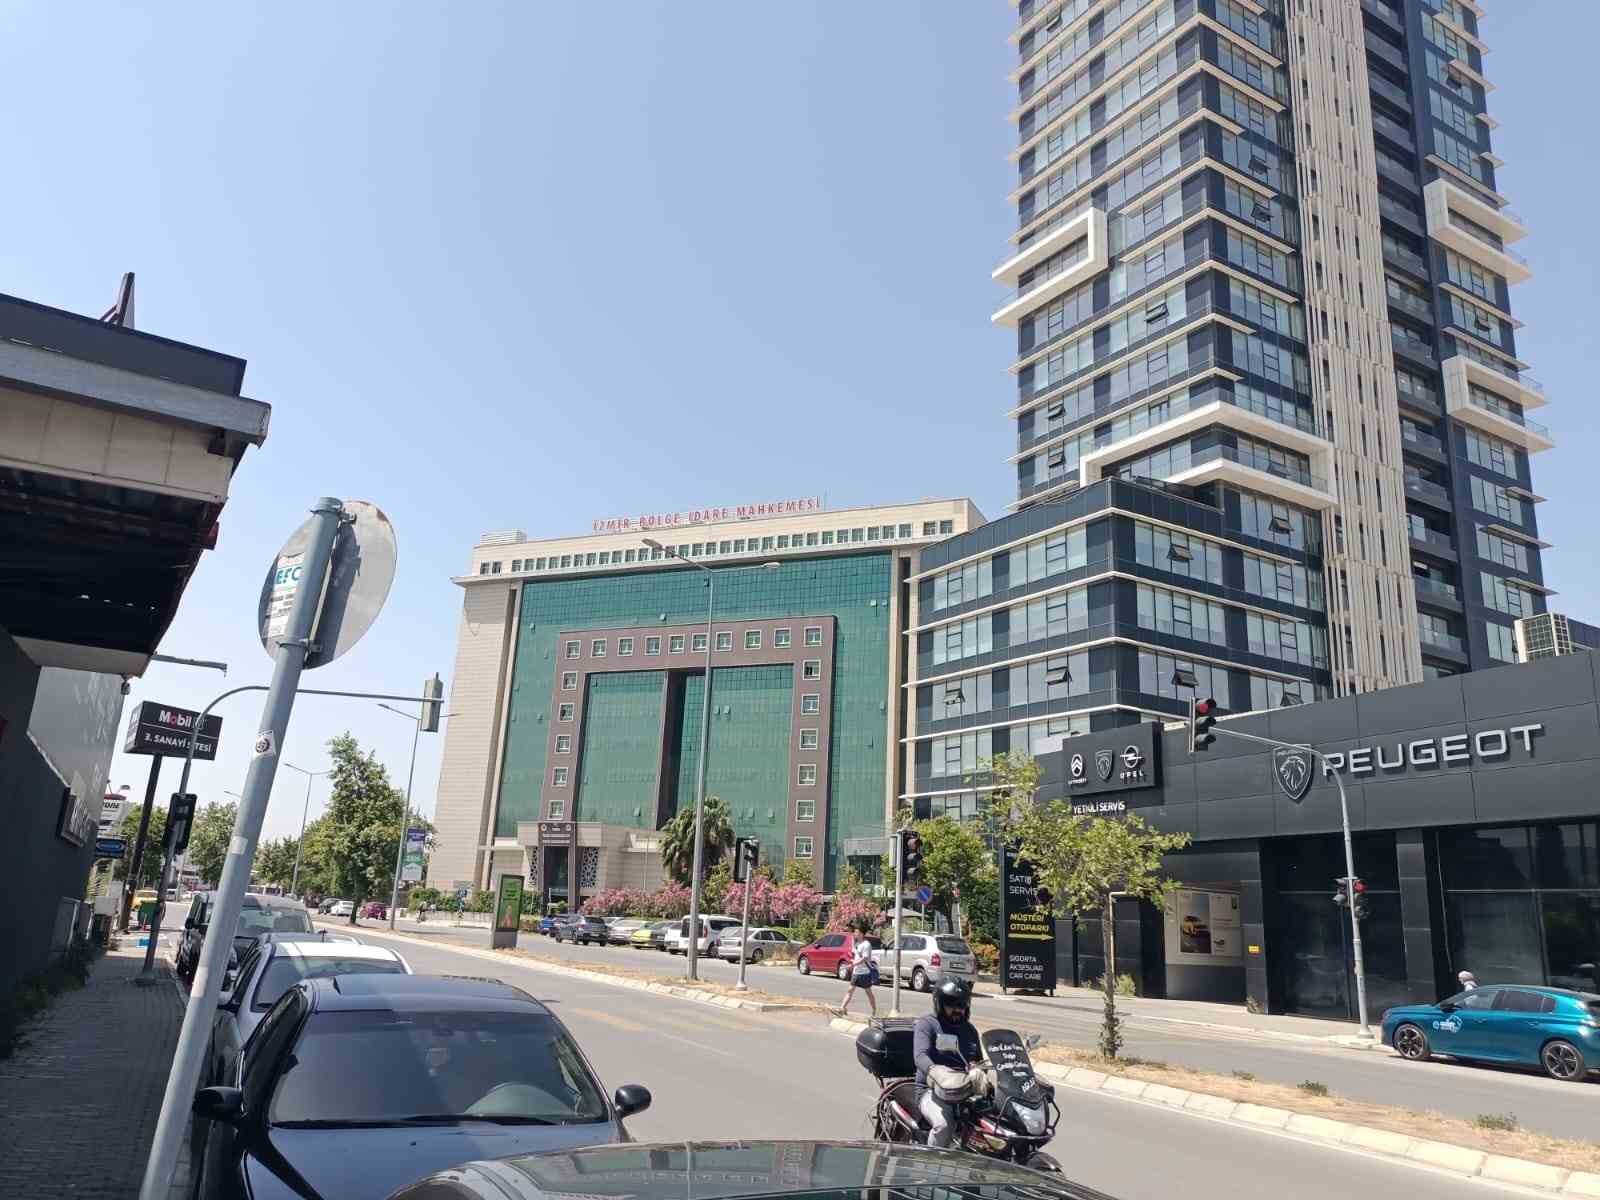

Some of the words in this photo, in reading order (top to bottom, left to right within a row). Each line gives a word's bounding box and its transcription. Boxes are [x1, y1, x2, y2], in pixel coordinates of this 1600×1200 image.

[159, 709, 192, 728] Mobil
[186, 740, 212, 753] STESİ
[1322, 723, 1542, 776] PEUGEOT
[1120, 769, 1144, 780] OPEL
